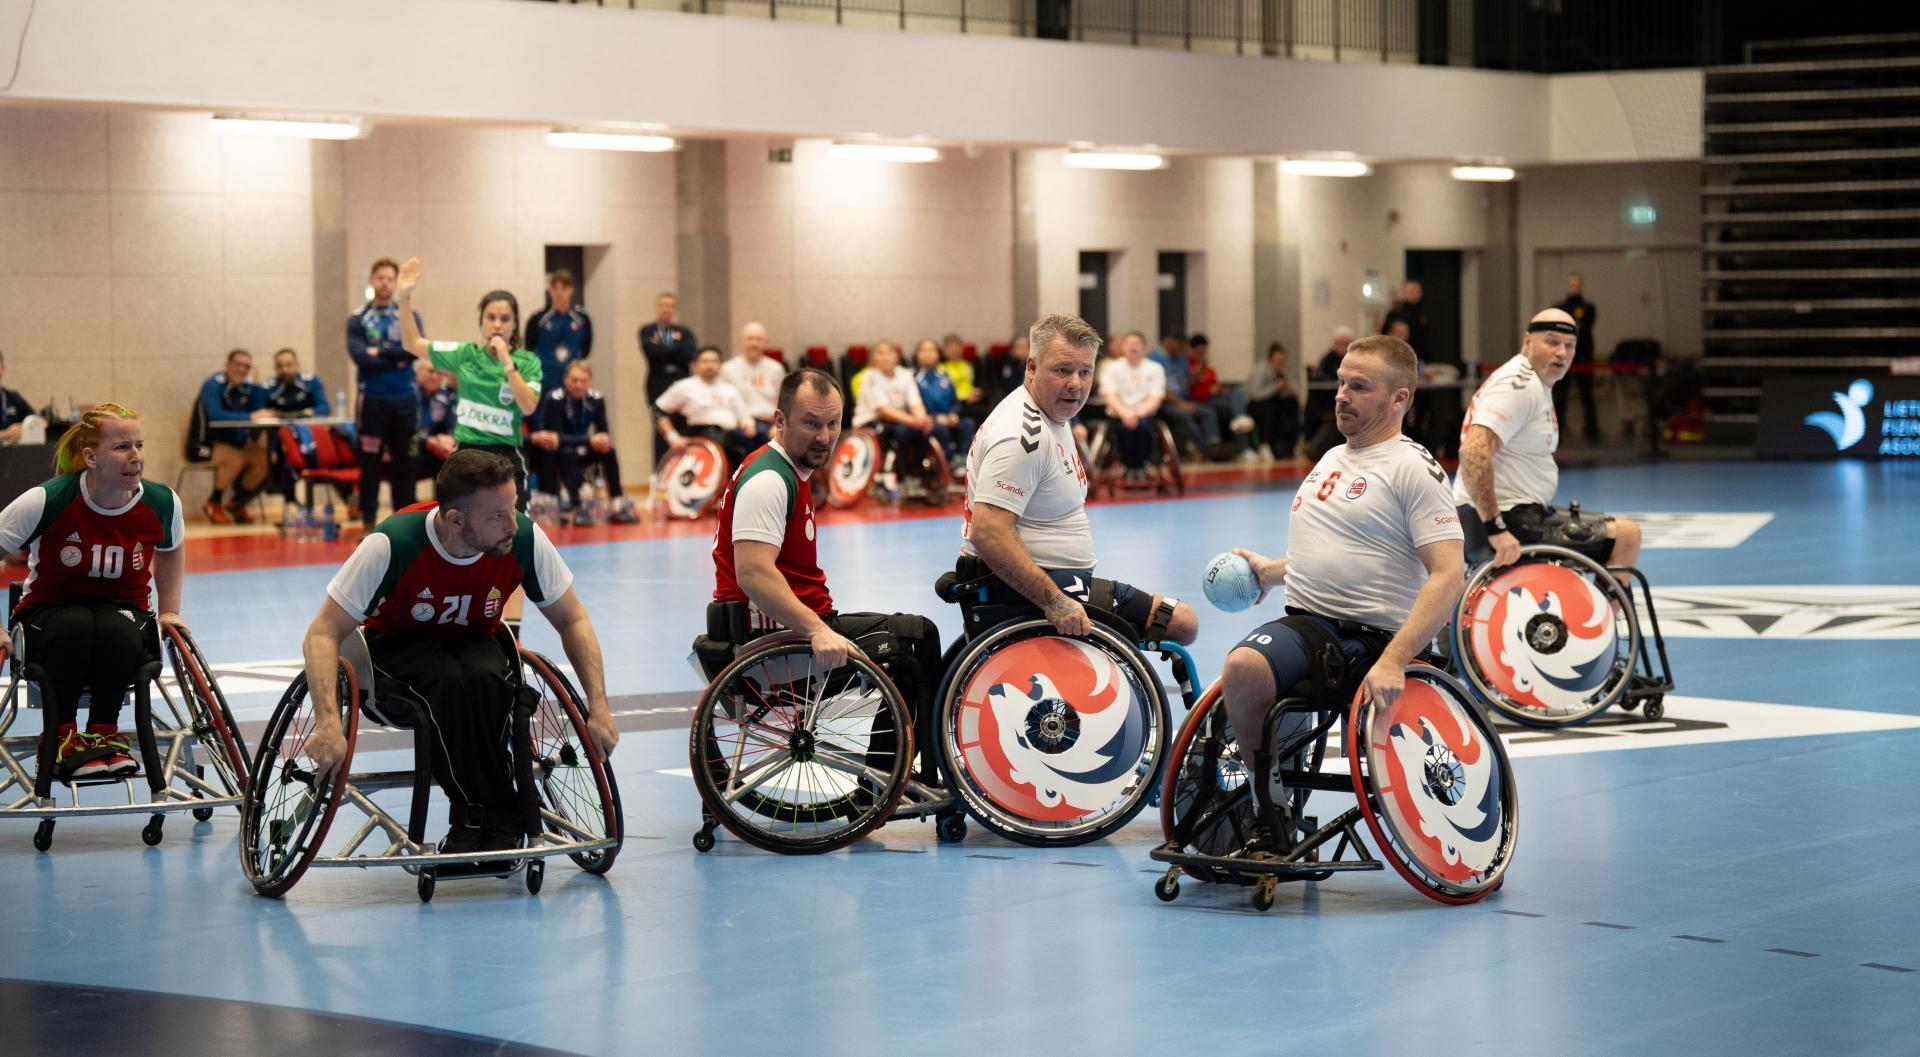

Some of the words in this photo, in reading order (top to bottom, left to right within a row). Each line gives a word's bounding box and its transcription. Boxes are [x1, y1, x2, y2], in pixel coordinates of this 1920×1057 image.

[469, 408, 511, 428] DEKRA
[995, 480, 1025, 497] Scandic
[1317, 471, 1342, 501] 6
[87, 544, 125, 579] 10
[1207, 555, 1233, 585] SELECT
[437, 595, 473, 626] 21
[1246, 633, 1273, 645] 10
